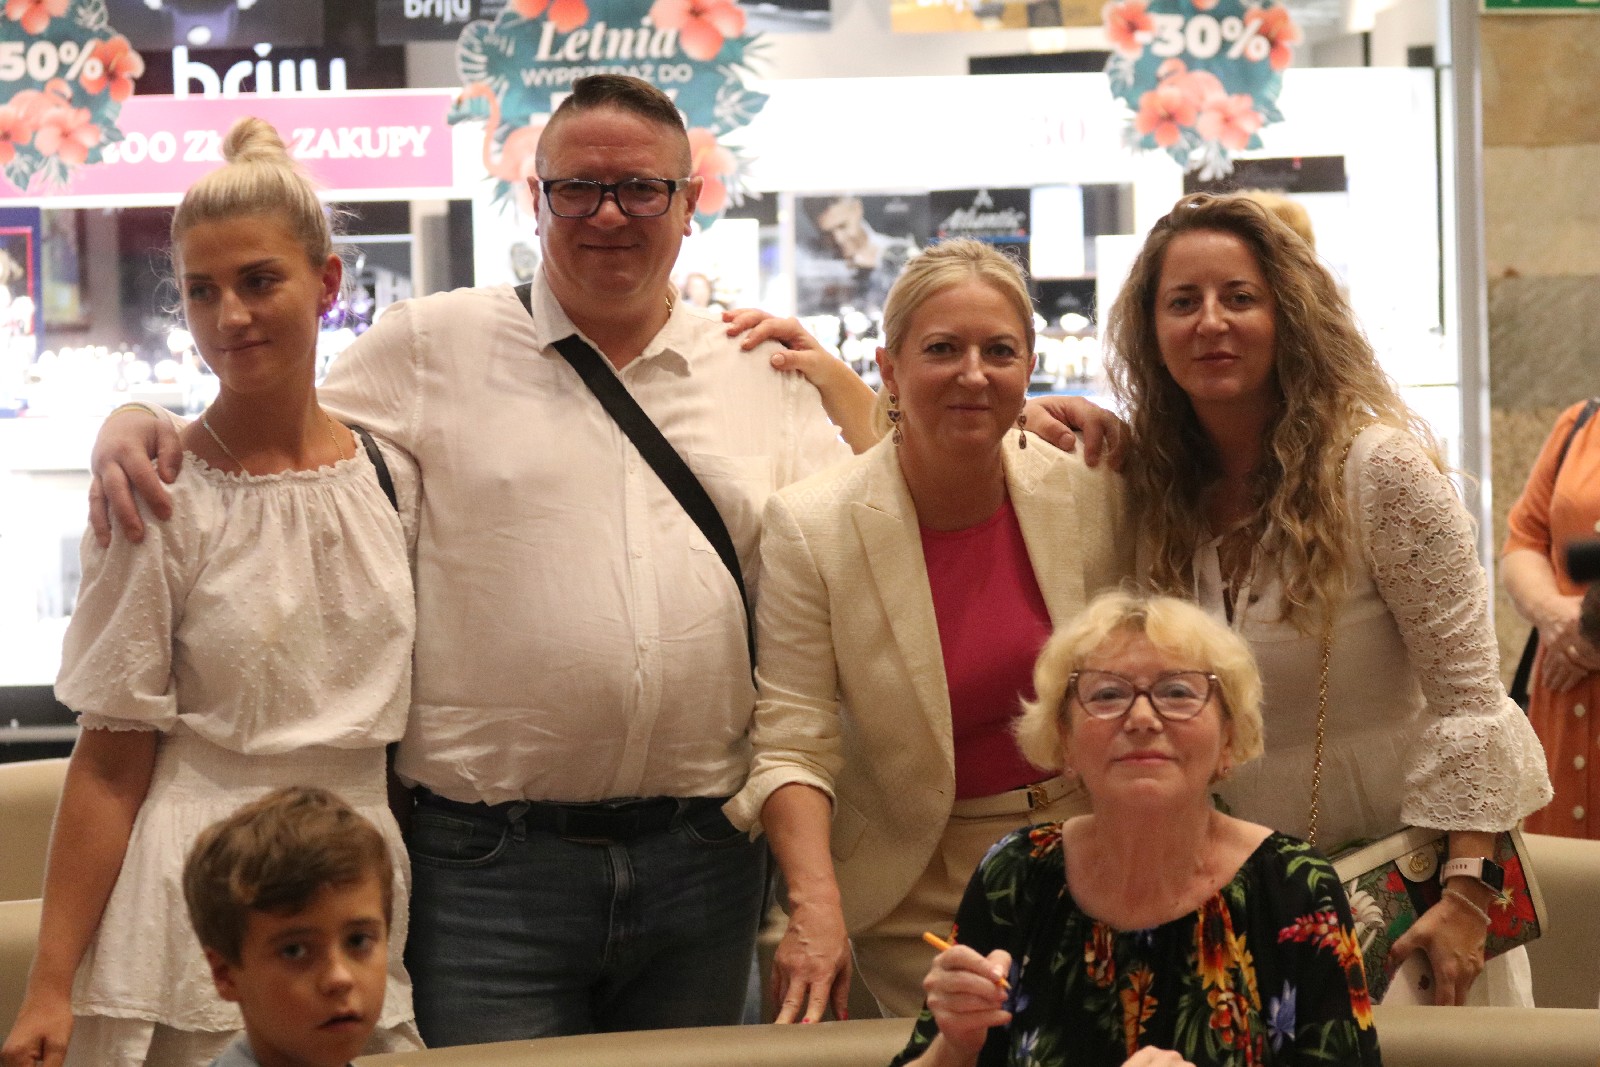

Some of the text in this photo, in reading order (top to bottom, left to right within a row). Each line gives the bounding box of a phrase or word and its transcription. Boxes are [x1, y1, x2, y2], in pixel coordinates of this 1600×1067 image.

[535, 16, 678, 61] Letnia
[658, 63, 693, 83] DO
[292, 125, 430, 159] ZAKUPY
